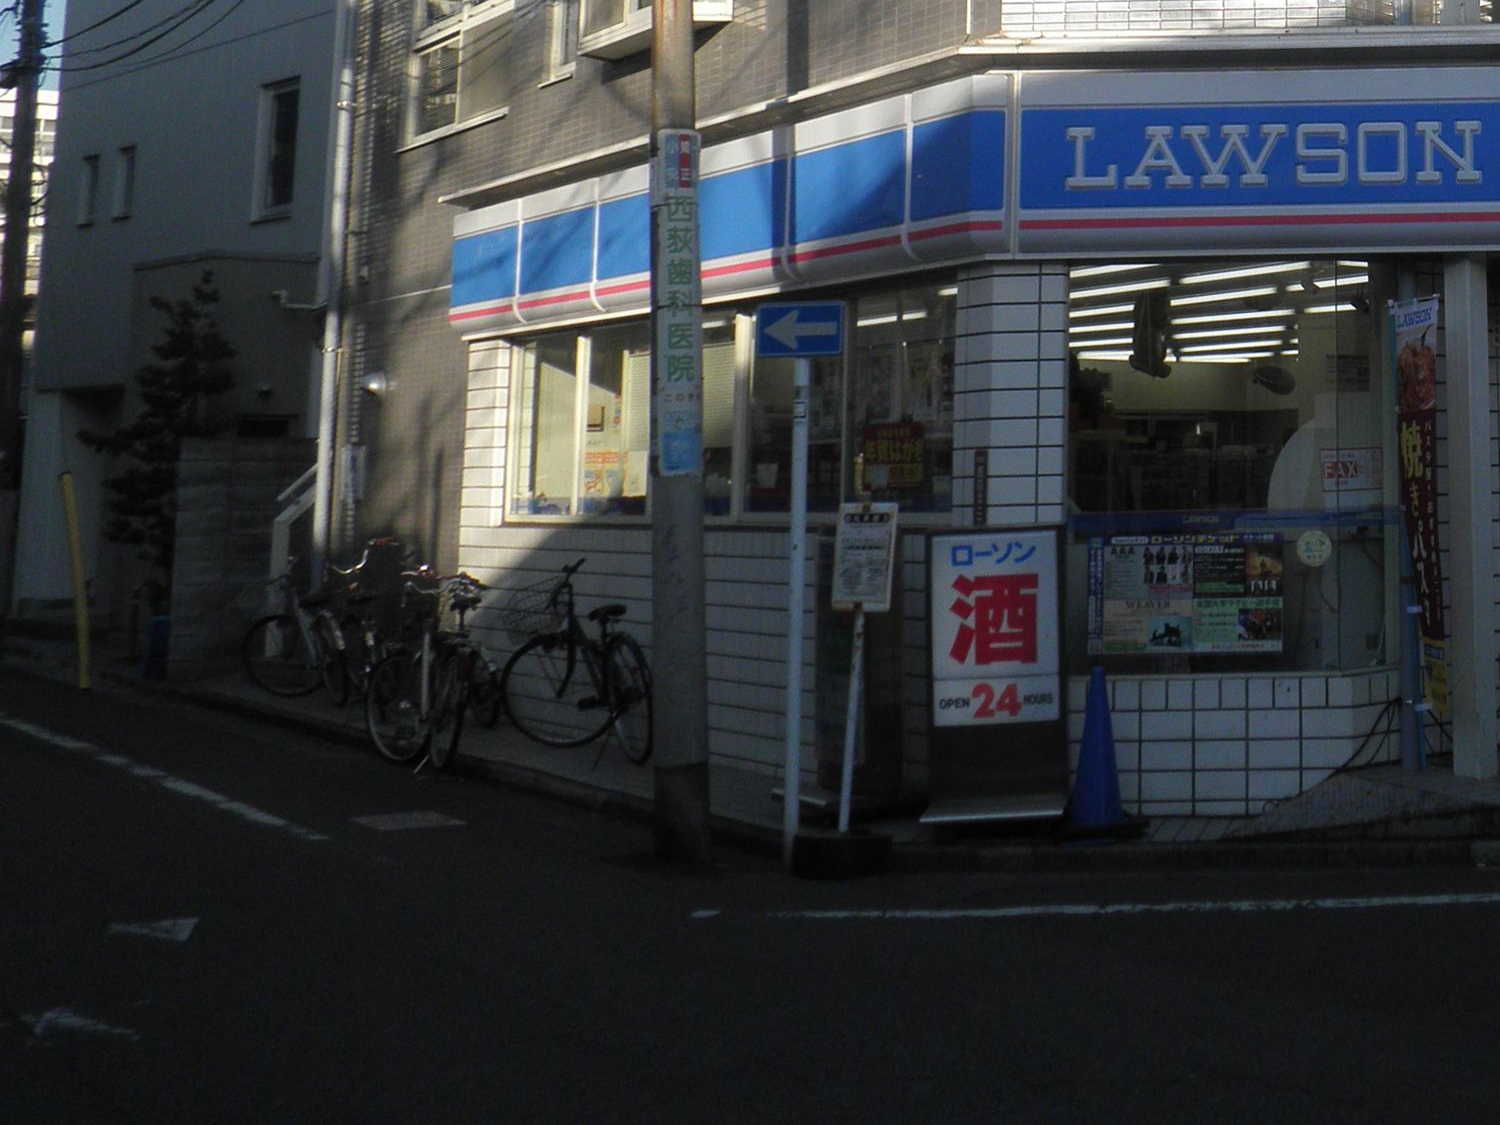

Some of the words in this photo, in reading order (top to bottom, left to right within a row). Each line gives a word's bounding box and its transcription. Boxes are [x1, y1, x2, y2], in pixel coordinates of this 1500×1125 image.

[1064, 119, 1485, 192] LAWSON
[666, 195, 694, 385] 西荻歯科医院
[1323, 461, 1358, 479] FAX
[951, 541, 1036, 567] ローソン
[949, 573, 1038, 666] 酒
[939, 697, 970, 710] OPEN
[972, 683, 1022, 719] 24
[1023, 693, 1053, 705] HOURS
